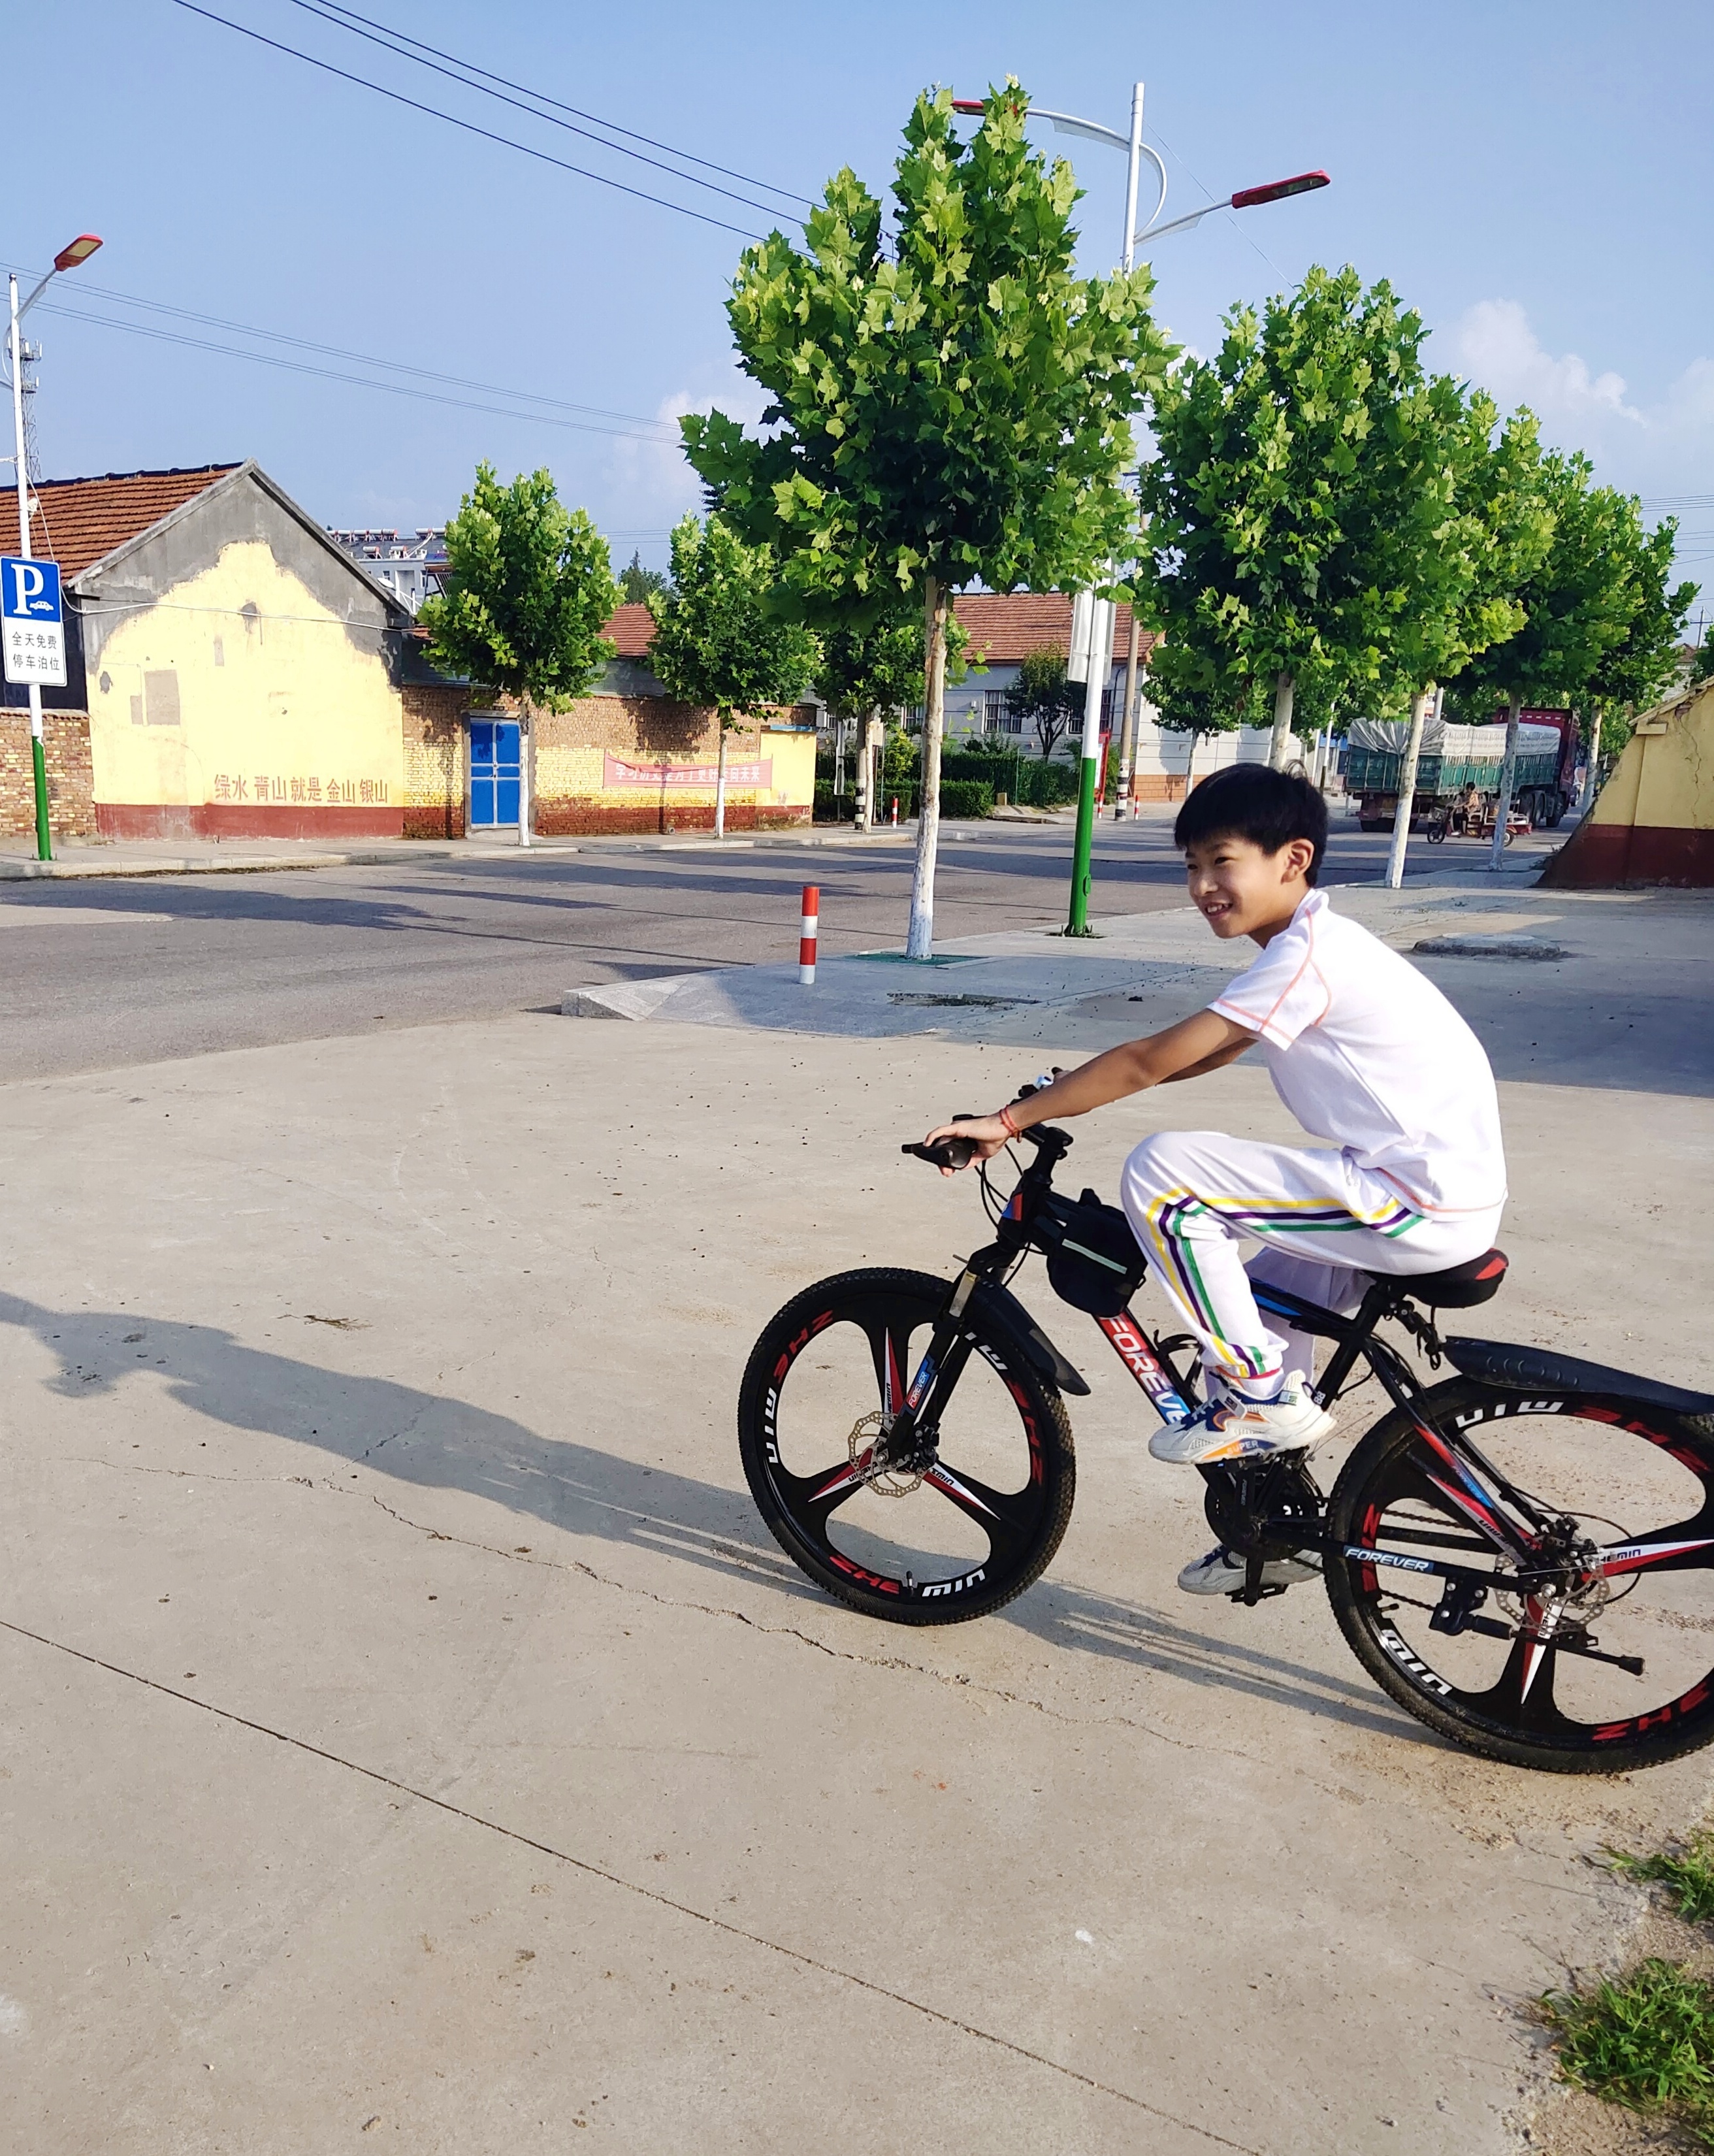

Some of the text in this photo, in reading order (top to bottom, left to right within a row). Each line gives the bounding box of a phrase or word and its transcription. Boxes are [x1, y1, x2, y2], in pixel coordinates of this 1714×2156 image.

[11, 563, 44, 615] P
[12, 631, 57, 650] 全天免费
[12, 653, 60, 670] 停车泊位
[1099, 1315, 1188, 1424] FOREVE
[908, 1371, 928, 1409] FOREVER
[1226, 1439, 1259, 1455] SUPER
[1344, 1547, 1429, 1573] FOREVER
